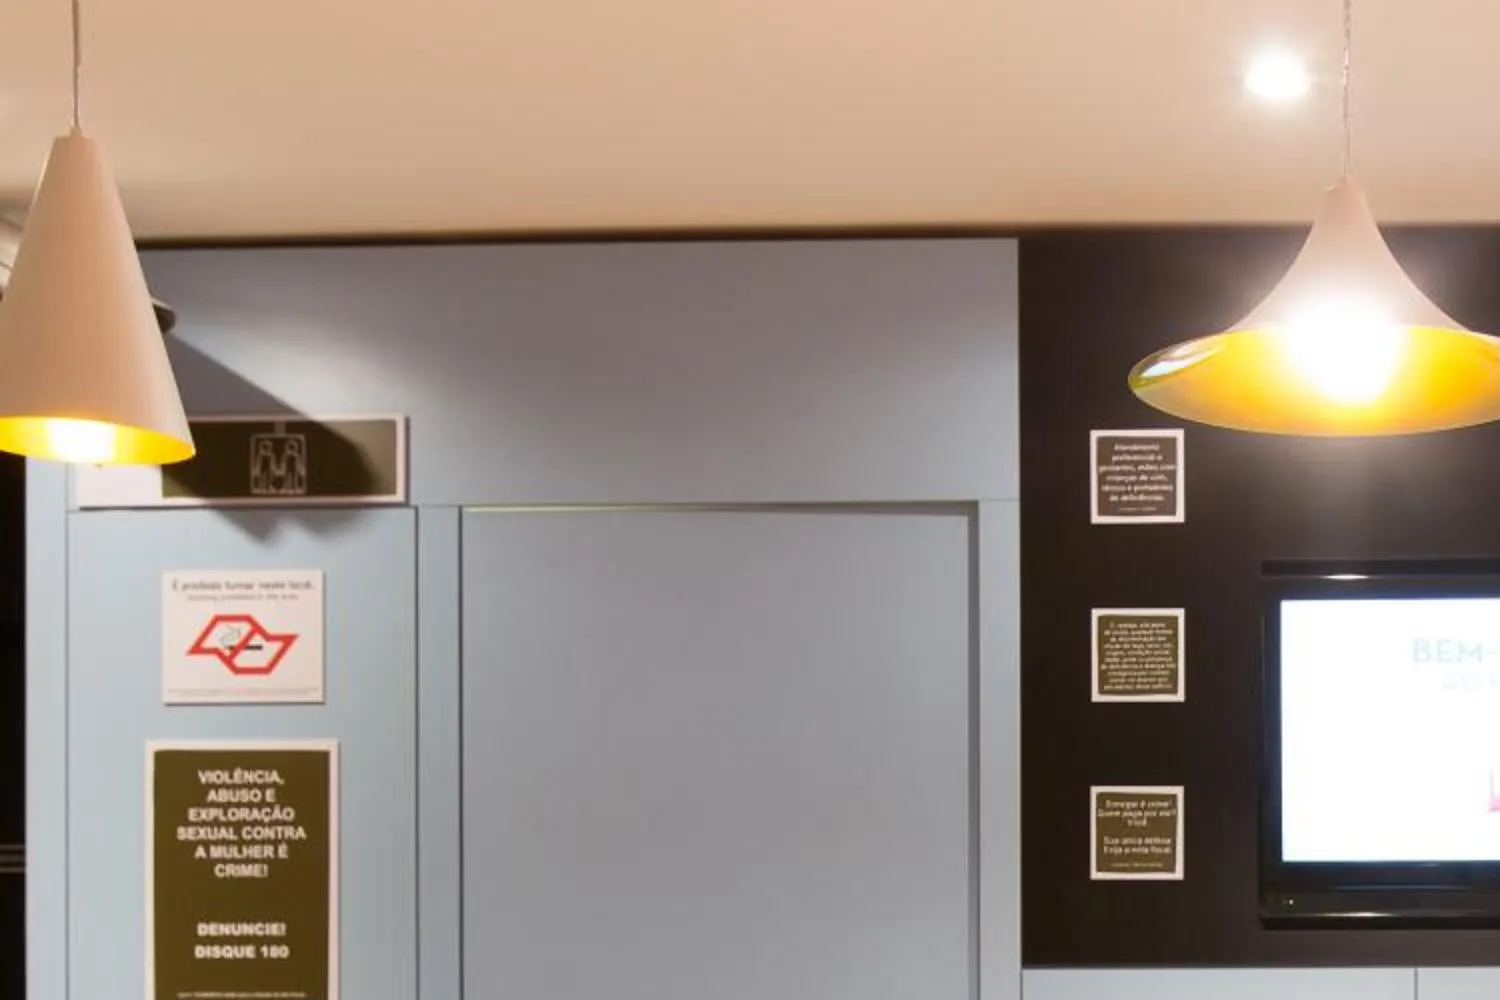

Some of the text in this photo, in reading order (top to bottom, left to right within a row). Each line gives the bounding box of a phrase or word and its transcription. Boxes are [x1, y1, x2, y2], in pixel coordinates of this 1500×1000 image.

[198, 768, 284, 785] VIOLÊNCIA,
[207, 789, 276, 802] ABUSO E
[188, 805, 296, 823] EXPLORAÇÃO
[177, 826, 307, 841] SEXUAL CONTRA
[194, 843, 289, 859] A MULHER É
[214, 864, 269, 877] CRIME!
[197, 922, 287, 936] DENUNCIE!
[194, 945, 256, 959] DISQUE
